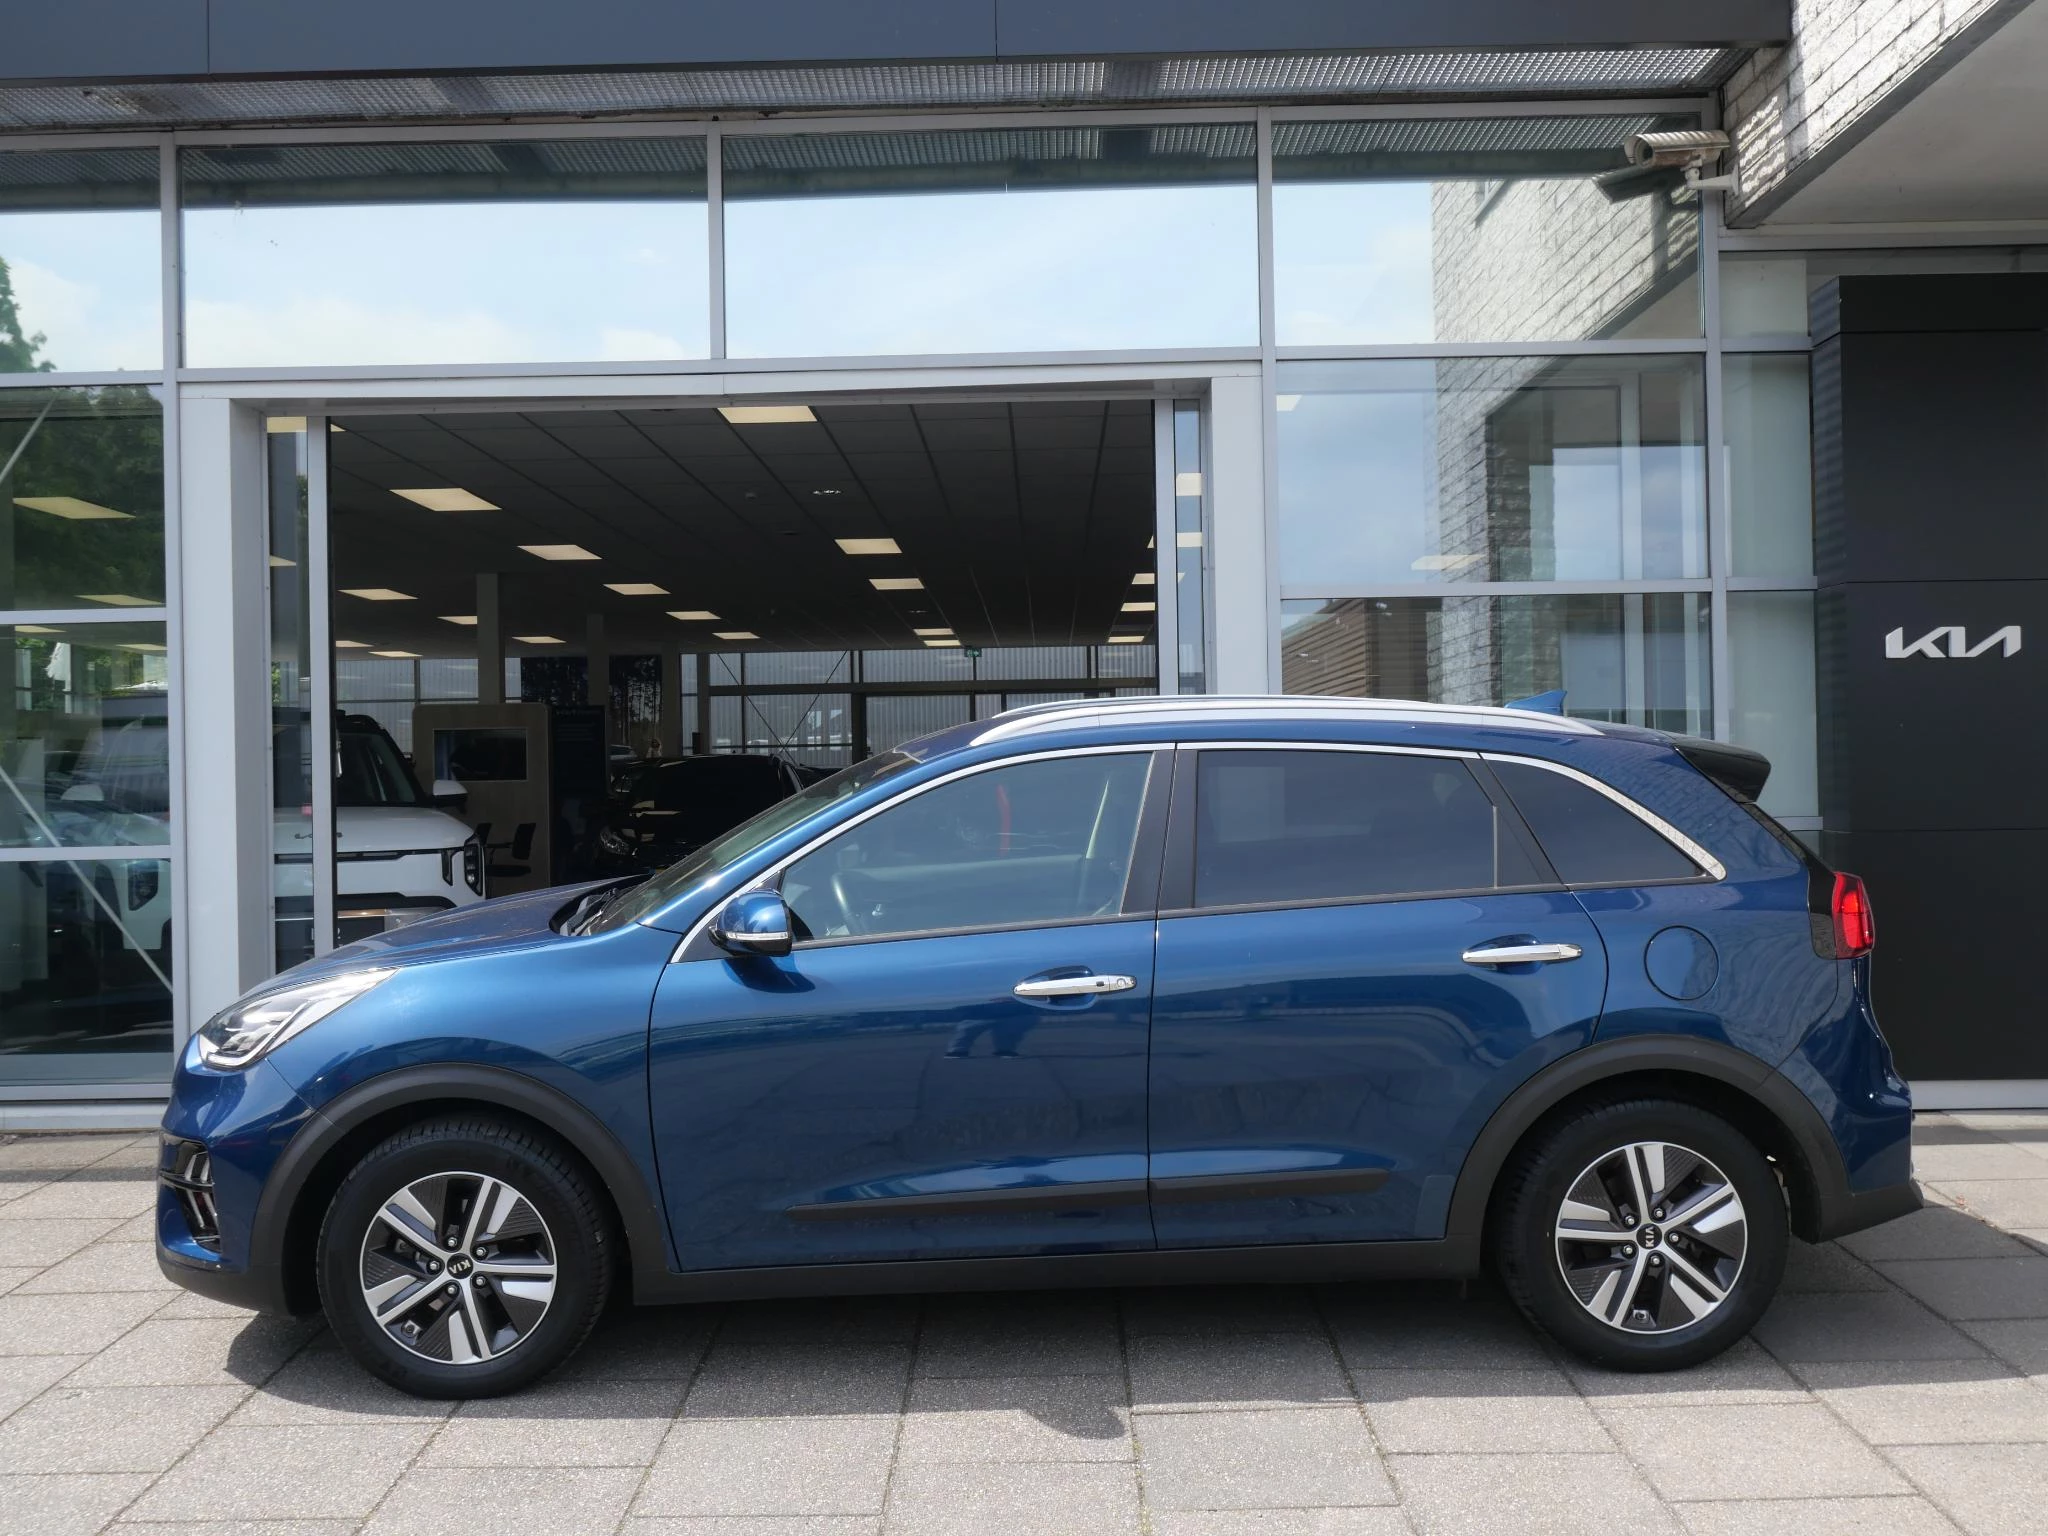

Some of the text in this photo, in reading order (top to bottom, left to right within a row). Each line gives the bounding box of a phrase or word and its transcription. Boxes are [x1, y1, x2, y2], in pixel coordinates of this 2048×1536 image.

[1885, 626, 2022, 658] KIA
[1645, 1226, 1655, 1248] KIA
[449, 1259, 471, 1274] KIA
